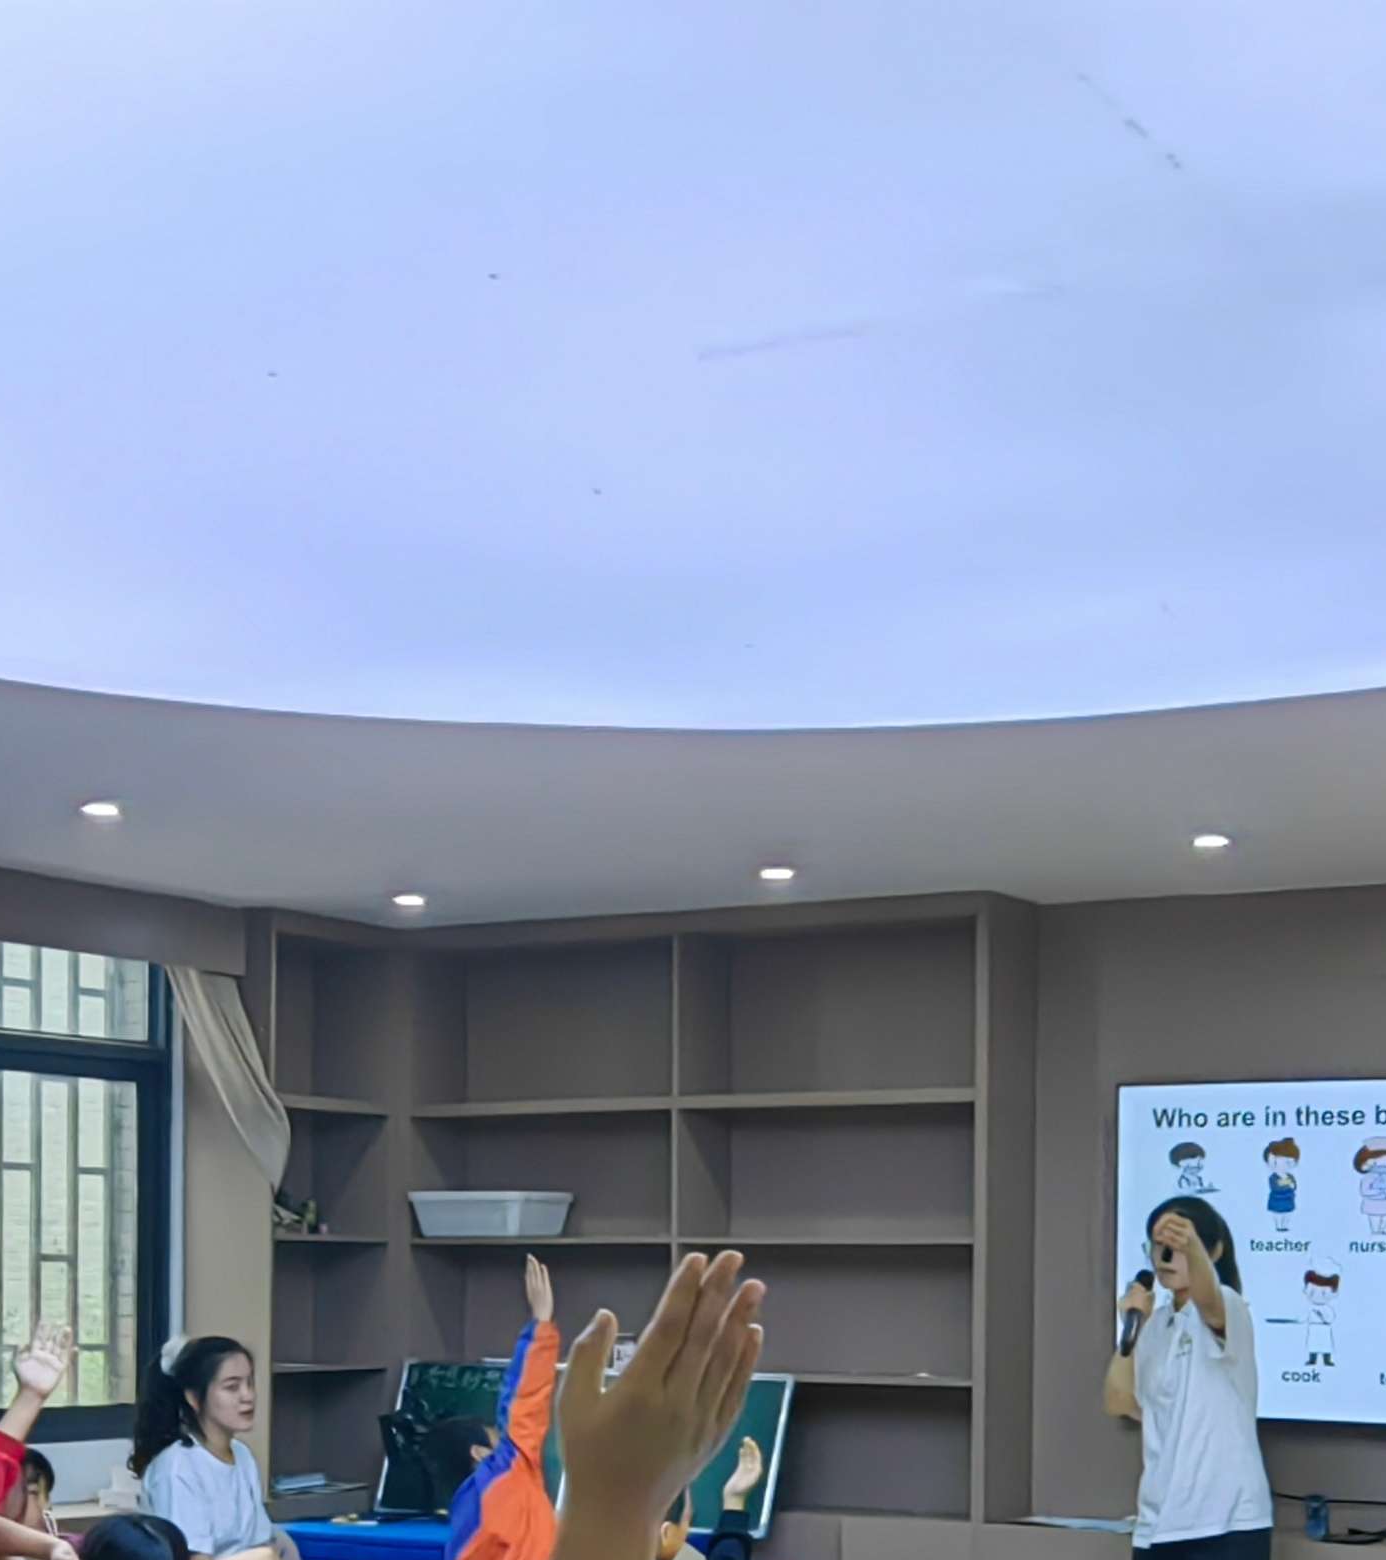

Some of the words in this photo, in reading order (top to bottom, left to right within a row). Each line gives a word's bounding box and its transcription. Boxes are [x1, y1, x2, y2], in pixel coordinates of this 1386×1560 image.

[1152, 1107, 1209, 1129] Who
[1216, 1111, 1256, 1128] are
[1264, 1105, 1287, 1127] in
[1295, 1104, 1366, 1127] these
[1249, 1238, 1312, 1252] teacher
[1280, 1369, 1321, 1384] cook
